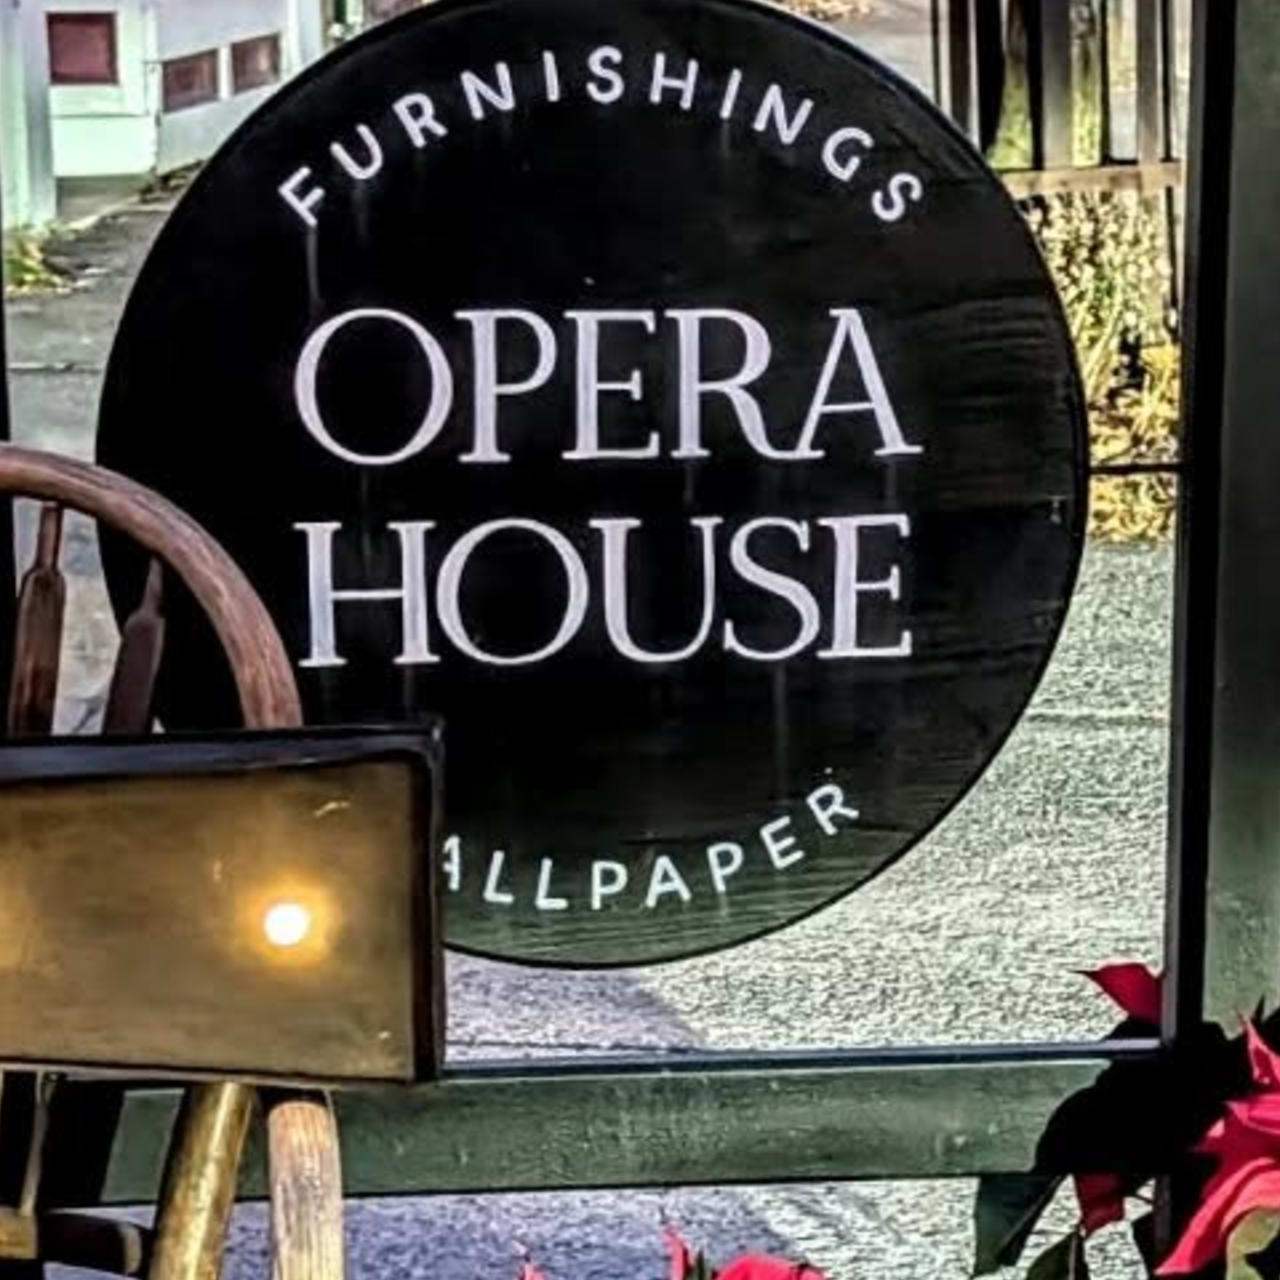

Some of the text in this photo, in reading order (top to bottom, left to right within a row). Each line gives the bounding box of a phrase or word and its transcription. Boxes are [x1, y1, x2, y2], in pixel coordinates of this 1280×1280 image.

[276, 44, 924, 227] FURNISHINGS
[296, 309, 922, 464] OPERA
[295, 514, 911, 666] HOUSE
[442, 783, 860, 910] ALLPAPER
